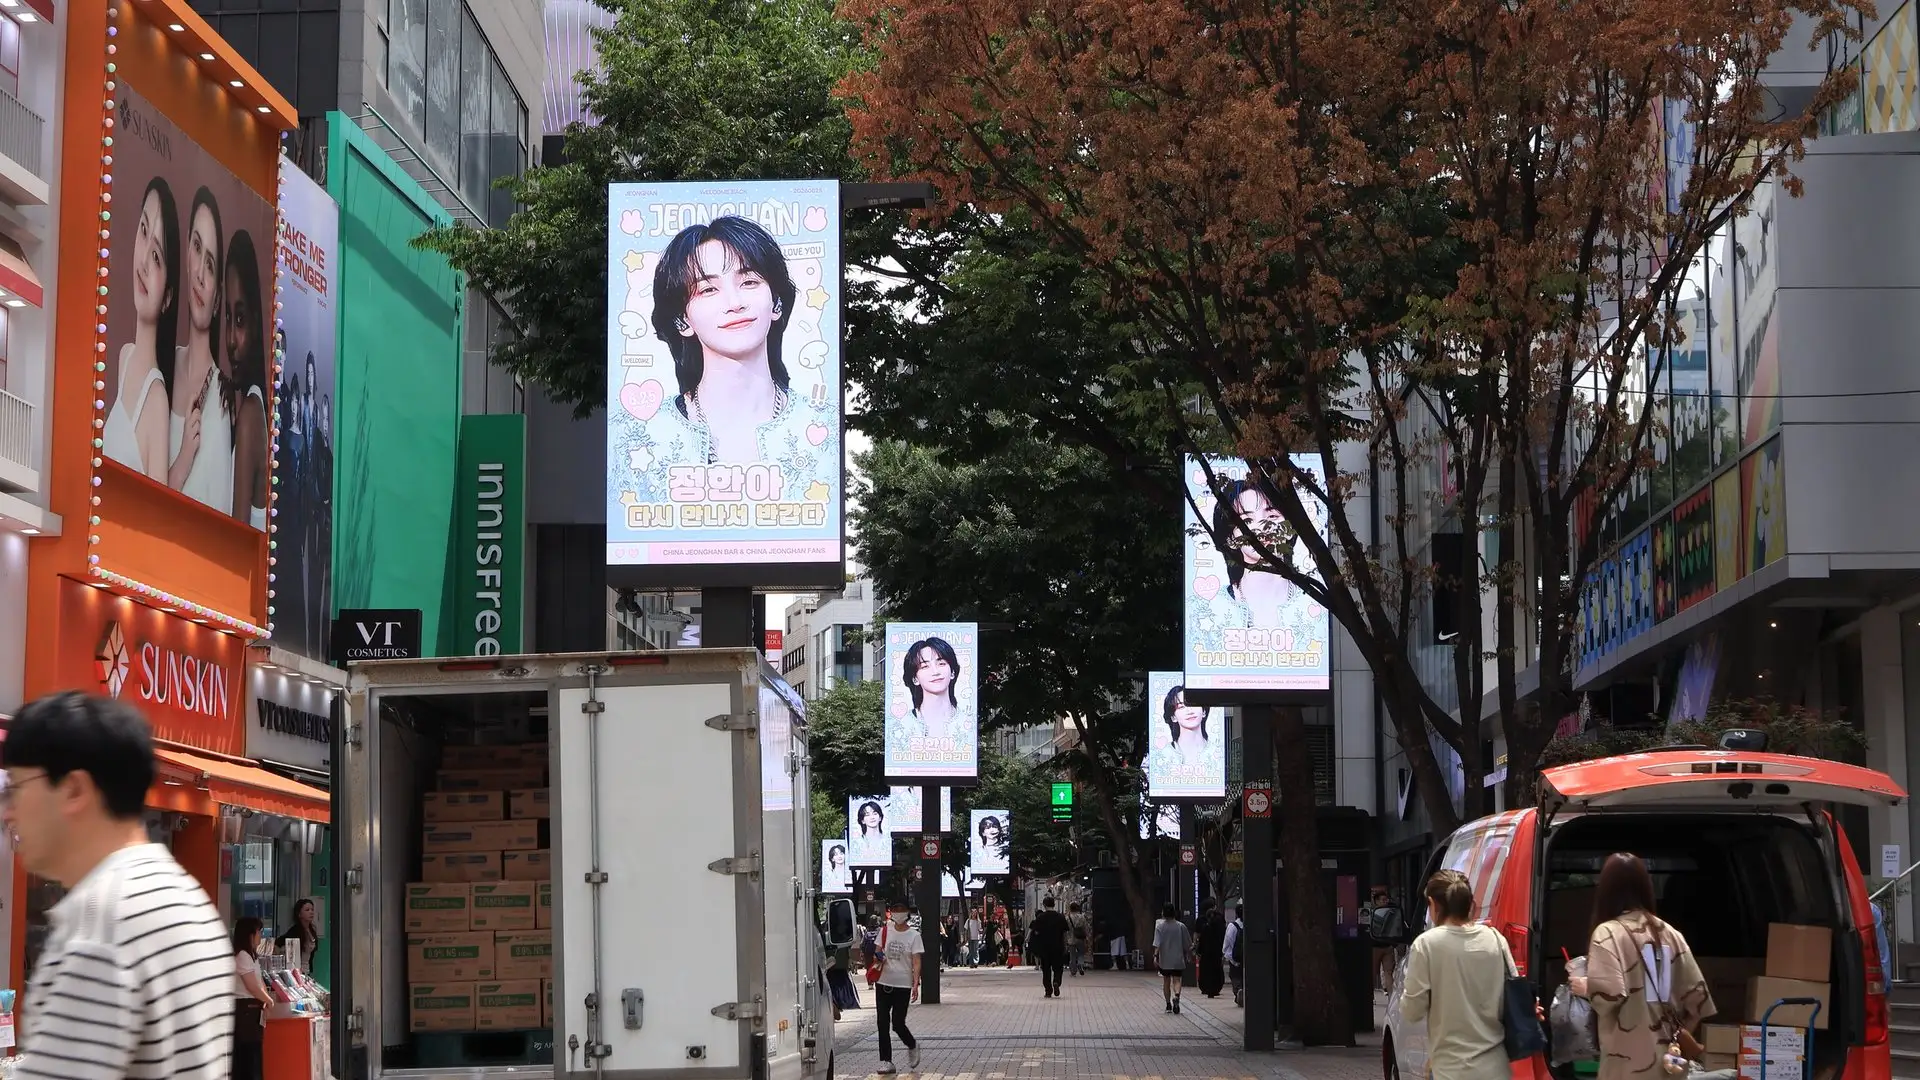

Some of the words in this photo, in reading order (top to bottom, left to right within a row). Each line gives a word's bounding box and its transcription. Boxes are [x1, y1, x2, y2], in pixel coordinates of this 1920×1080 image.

[310, 240, 325, 270] ME
[804, 246, 822, 255] YOU
[669, 465, 784, 503] 정한아
[627, 504, 674, 528] 다시
[680, 504, 748, 528] 만나서
[755, 503, 826, 526] 반갑다
[356, 622, 402, 646] VT
[1224, 628, 1294, 652] 정한아
[347, 648, 408, 658] COSMETICS
[1198, 652, 1227, 666] 다시
[140, 642, 228, 720] SUNSKIN
